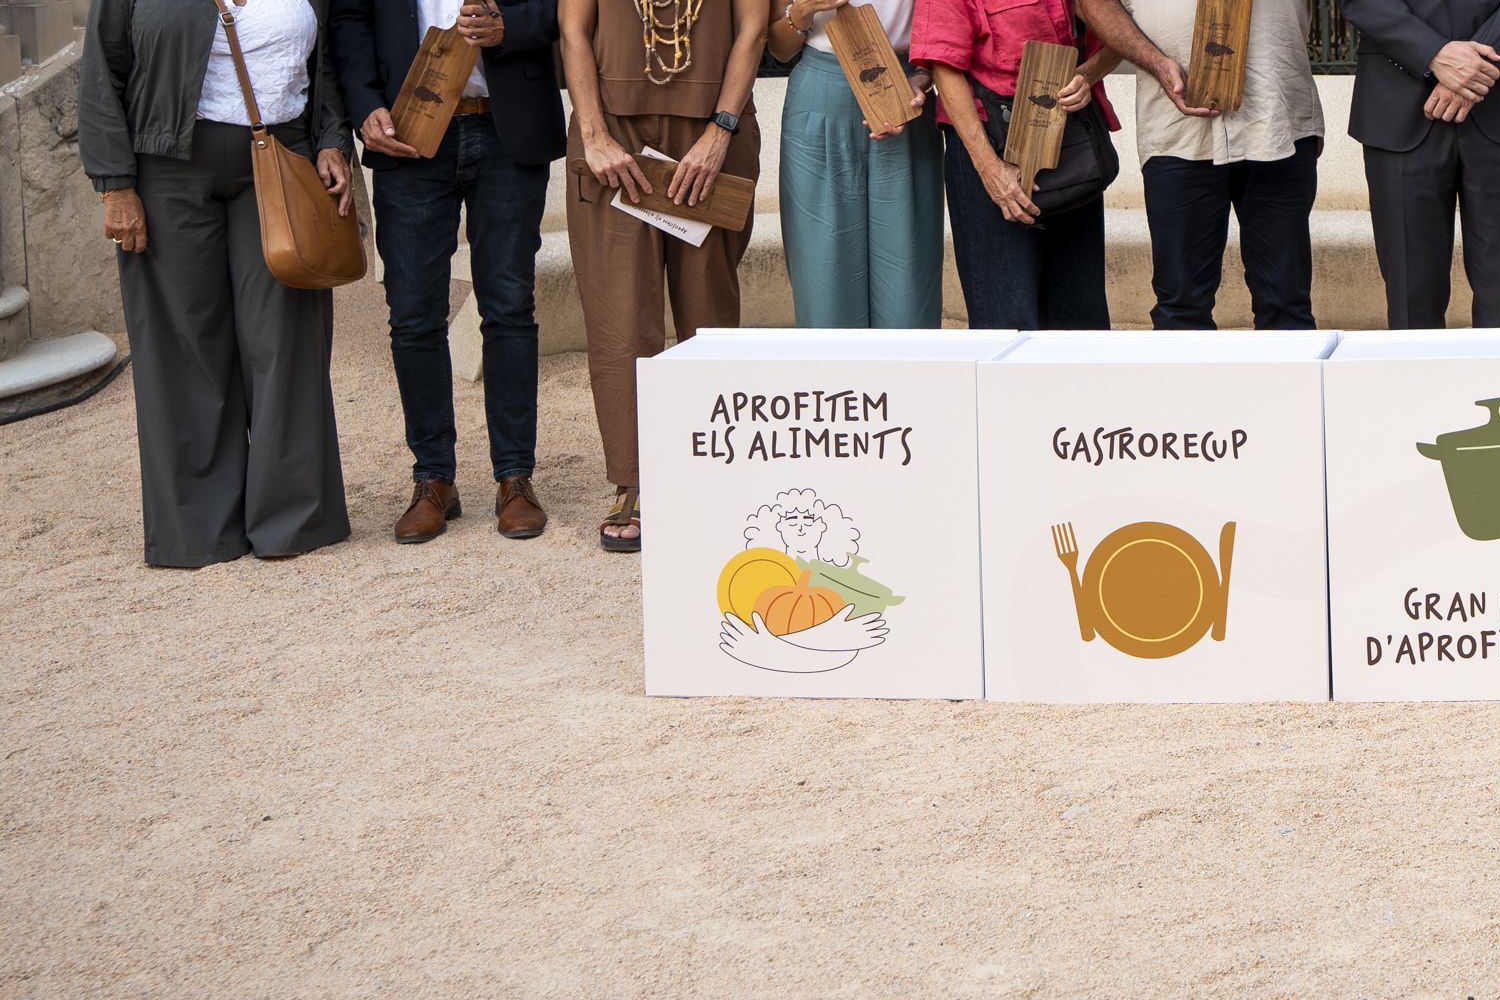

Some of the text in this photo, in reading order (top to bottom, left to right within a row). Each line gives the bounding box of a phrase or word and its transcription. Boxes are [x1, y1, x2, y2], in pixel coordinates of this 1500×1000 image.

[710, 389, 888, 424] APROFITEM
[692, 425, 913, 466] ELS ALIMENTS
[1052, 426, 1248, 467] GASTRORECUP
[1404, 587, 1486, 623] GRAN
